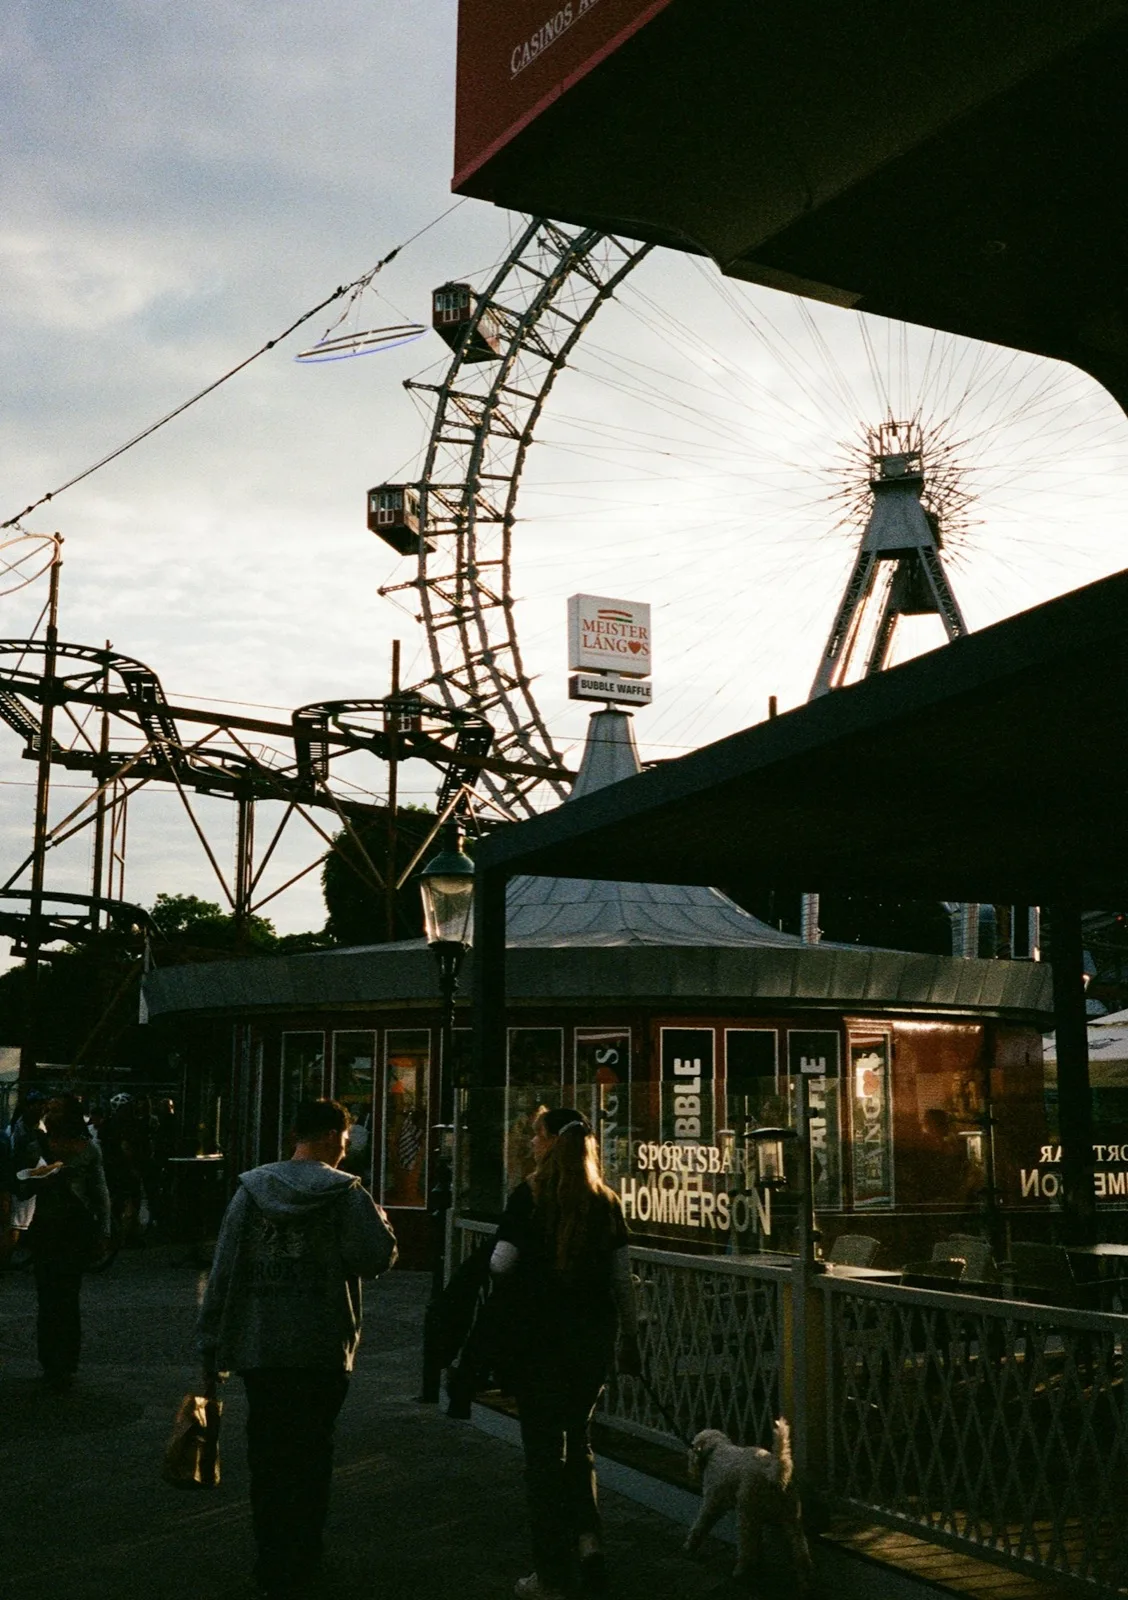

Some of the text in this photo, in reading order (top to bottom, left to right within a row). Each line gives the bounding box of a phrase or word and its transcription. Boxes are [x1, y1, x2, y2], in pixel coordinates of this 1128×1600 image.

[510, 2, 573, 74] CASINOS
[582, 619, 649, 640] MEISTER
[581, 680, 652, 697] BUBBLE WAFFLE
[637, 1142, 747, 1175] SPORTSBAR
[620, 1176, 772, 1236] HOMMERSON
